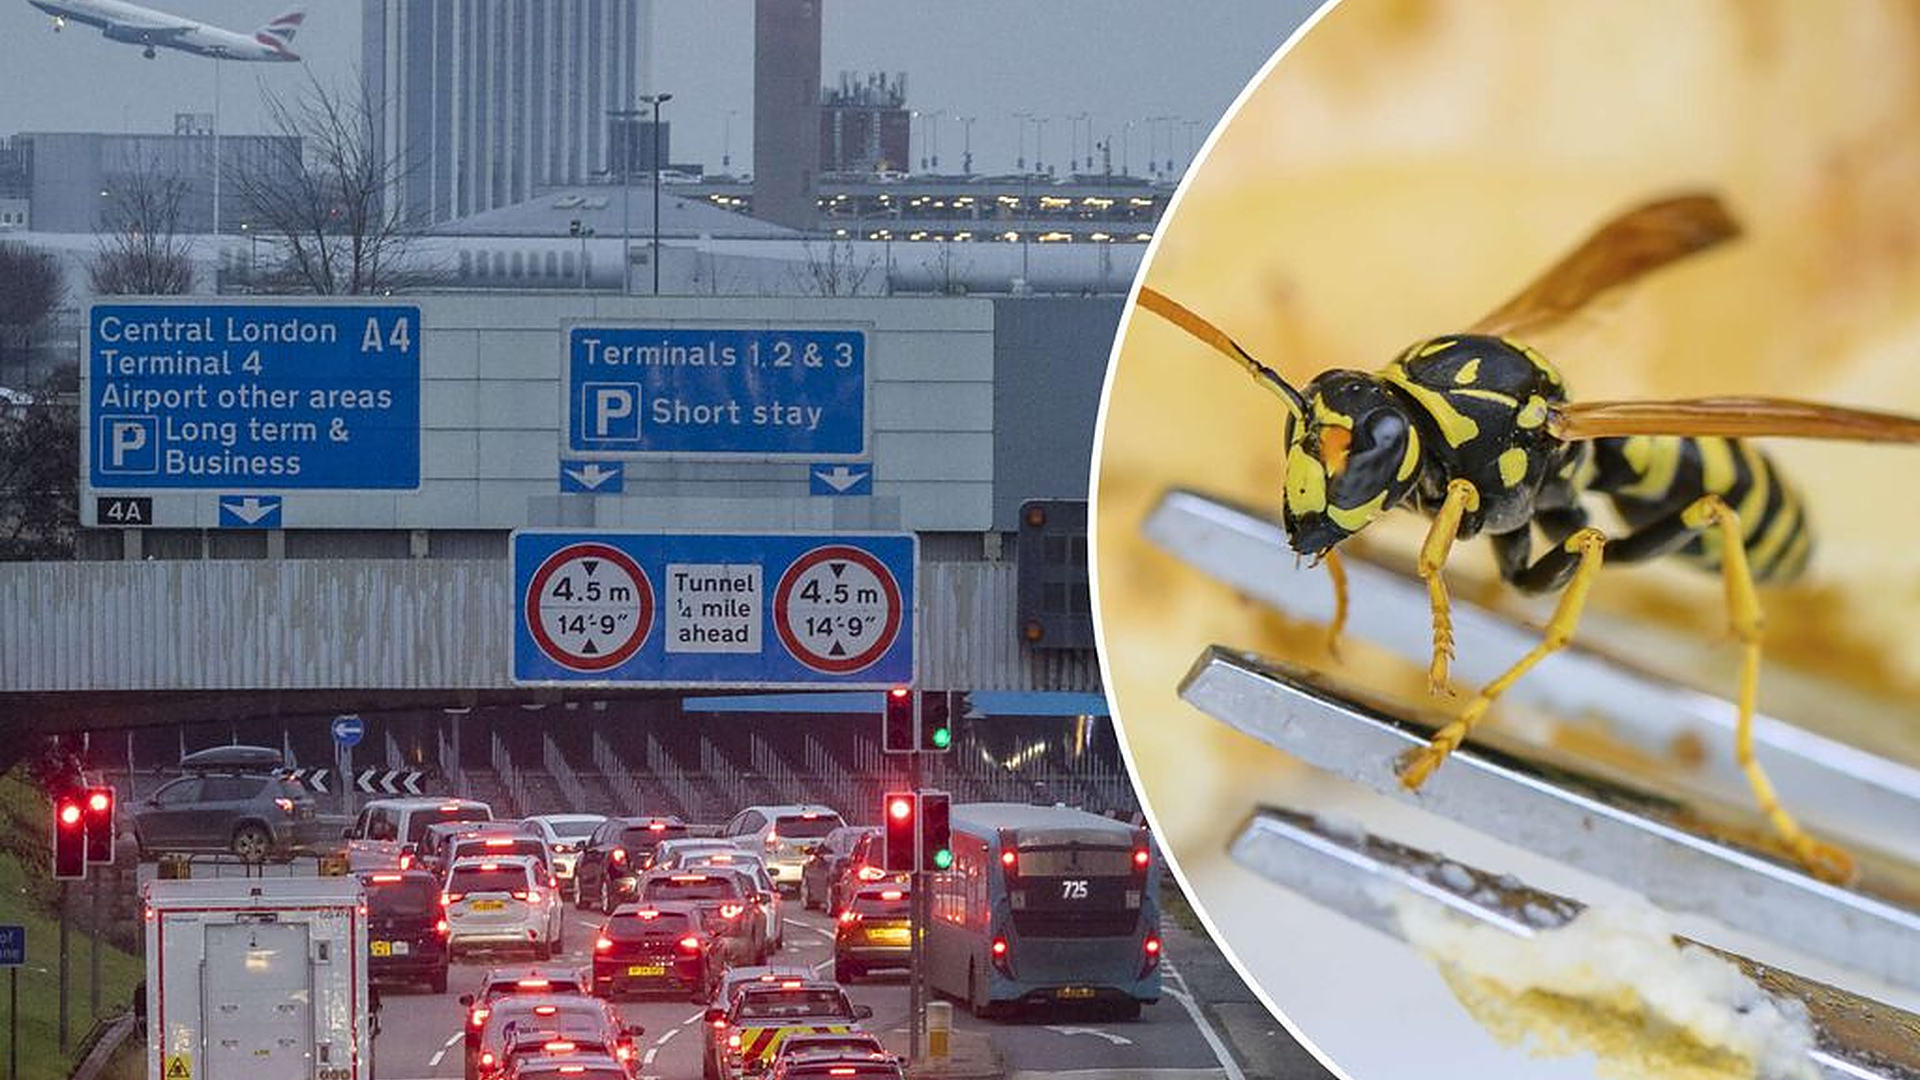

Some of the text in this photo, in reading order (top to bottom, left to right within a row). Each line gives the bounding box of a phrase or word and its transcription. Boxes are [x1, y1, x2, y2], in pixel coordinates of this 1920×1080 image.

[100, 316, 337, 343] Central London
[361, 316, 411, 353] A4
[101, 350, 263, 375] Terminal 4
[583, 339, 737, 367] Terminals
[803, 342, 824, 368] &
[834, 342, 853, 368] 3
[100, 383, 392, 413] Airport other areas
[597, 389, 633, 436] P
[652, 398, 823, 431] Short stay
[166, 417, 350, 446] Long term &
[112, 423, 146, 466] P
[166, 450, 301, 475] Business
[107, 502, 142, 522] 4A
[552, 577, 631, 602] 4.5 m
[674, 573, 754, 593] Tunnel
[800, 579, 878, 604] 4.5 m
[702, 600, 751, 619] mile
[679, 625, 749, 643] ahead
[1063, 881, 1088, 899] 725
